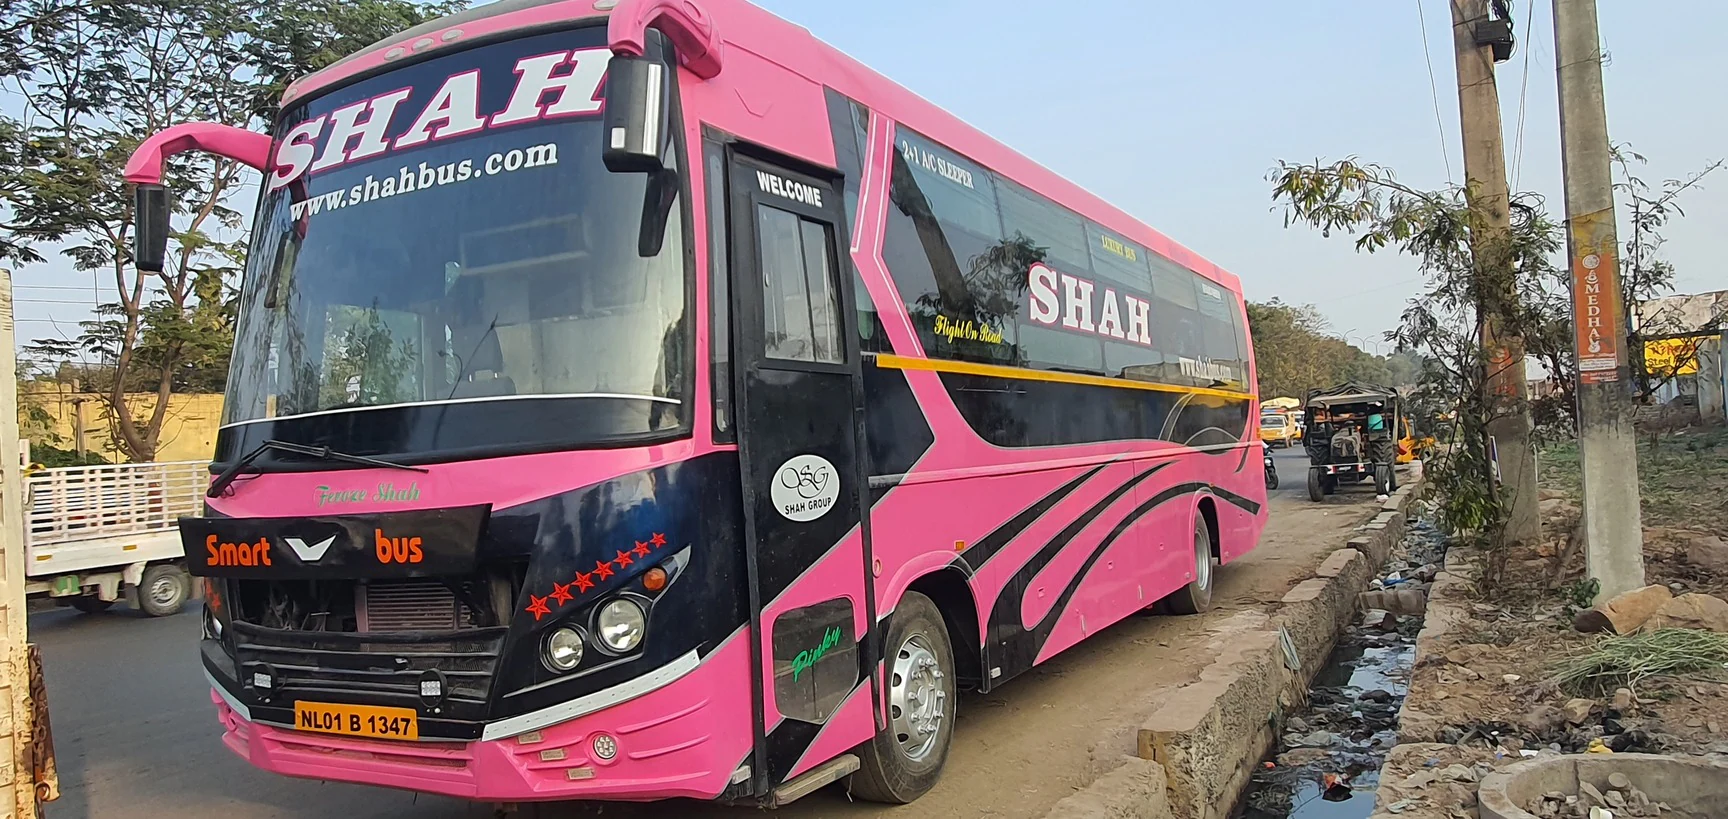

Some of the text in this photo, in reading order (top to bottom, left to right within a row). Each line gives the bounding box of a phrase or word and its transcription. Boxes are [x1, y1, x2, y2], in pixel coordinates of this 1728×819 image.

[268, 47, 613, 194] SHAH
[290, 141, 558, 223] www.shahbus.com
[756, 169, 823, 209] WELCOME
[922, 150, 937, 173] A/C
[937, 157, 975, 190] SLEEPER
[1101, 234, 1137, 262] LUXURY BUS
[1028, 261, 1152, 346] SHAH
[934, 314, 965, 344] Flight
[965, 320, 979, 341] On
[373, 480, 420, 503] Shah
[784, 497, 832, 515] SHAH GROUP
[206, 528, 423, 566] Smart bus
[792, 626, 842, 683] Pinky
[301, 710, 411, 736] NL01 B 1347
